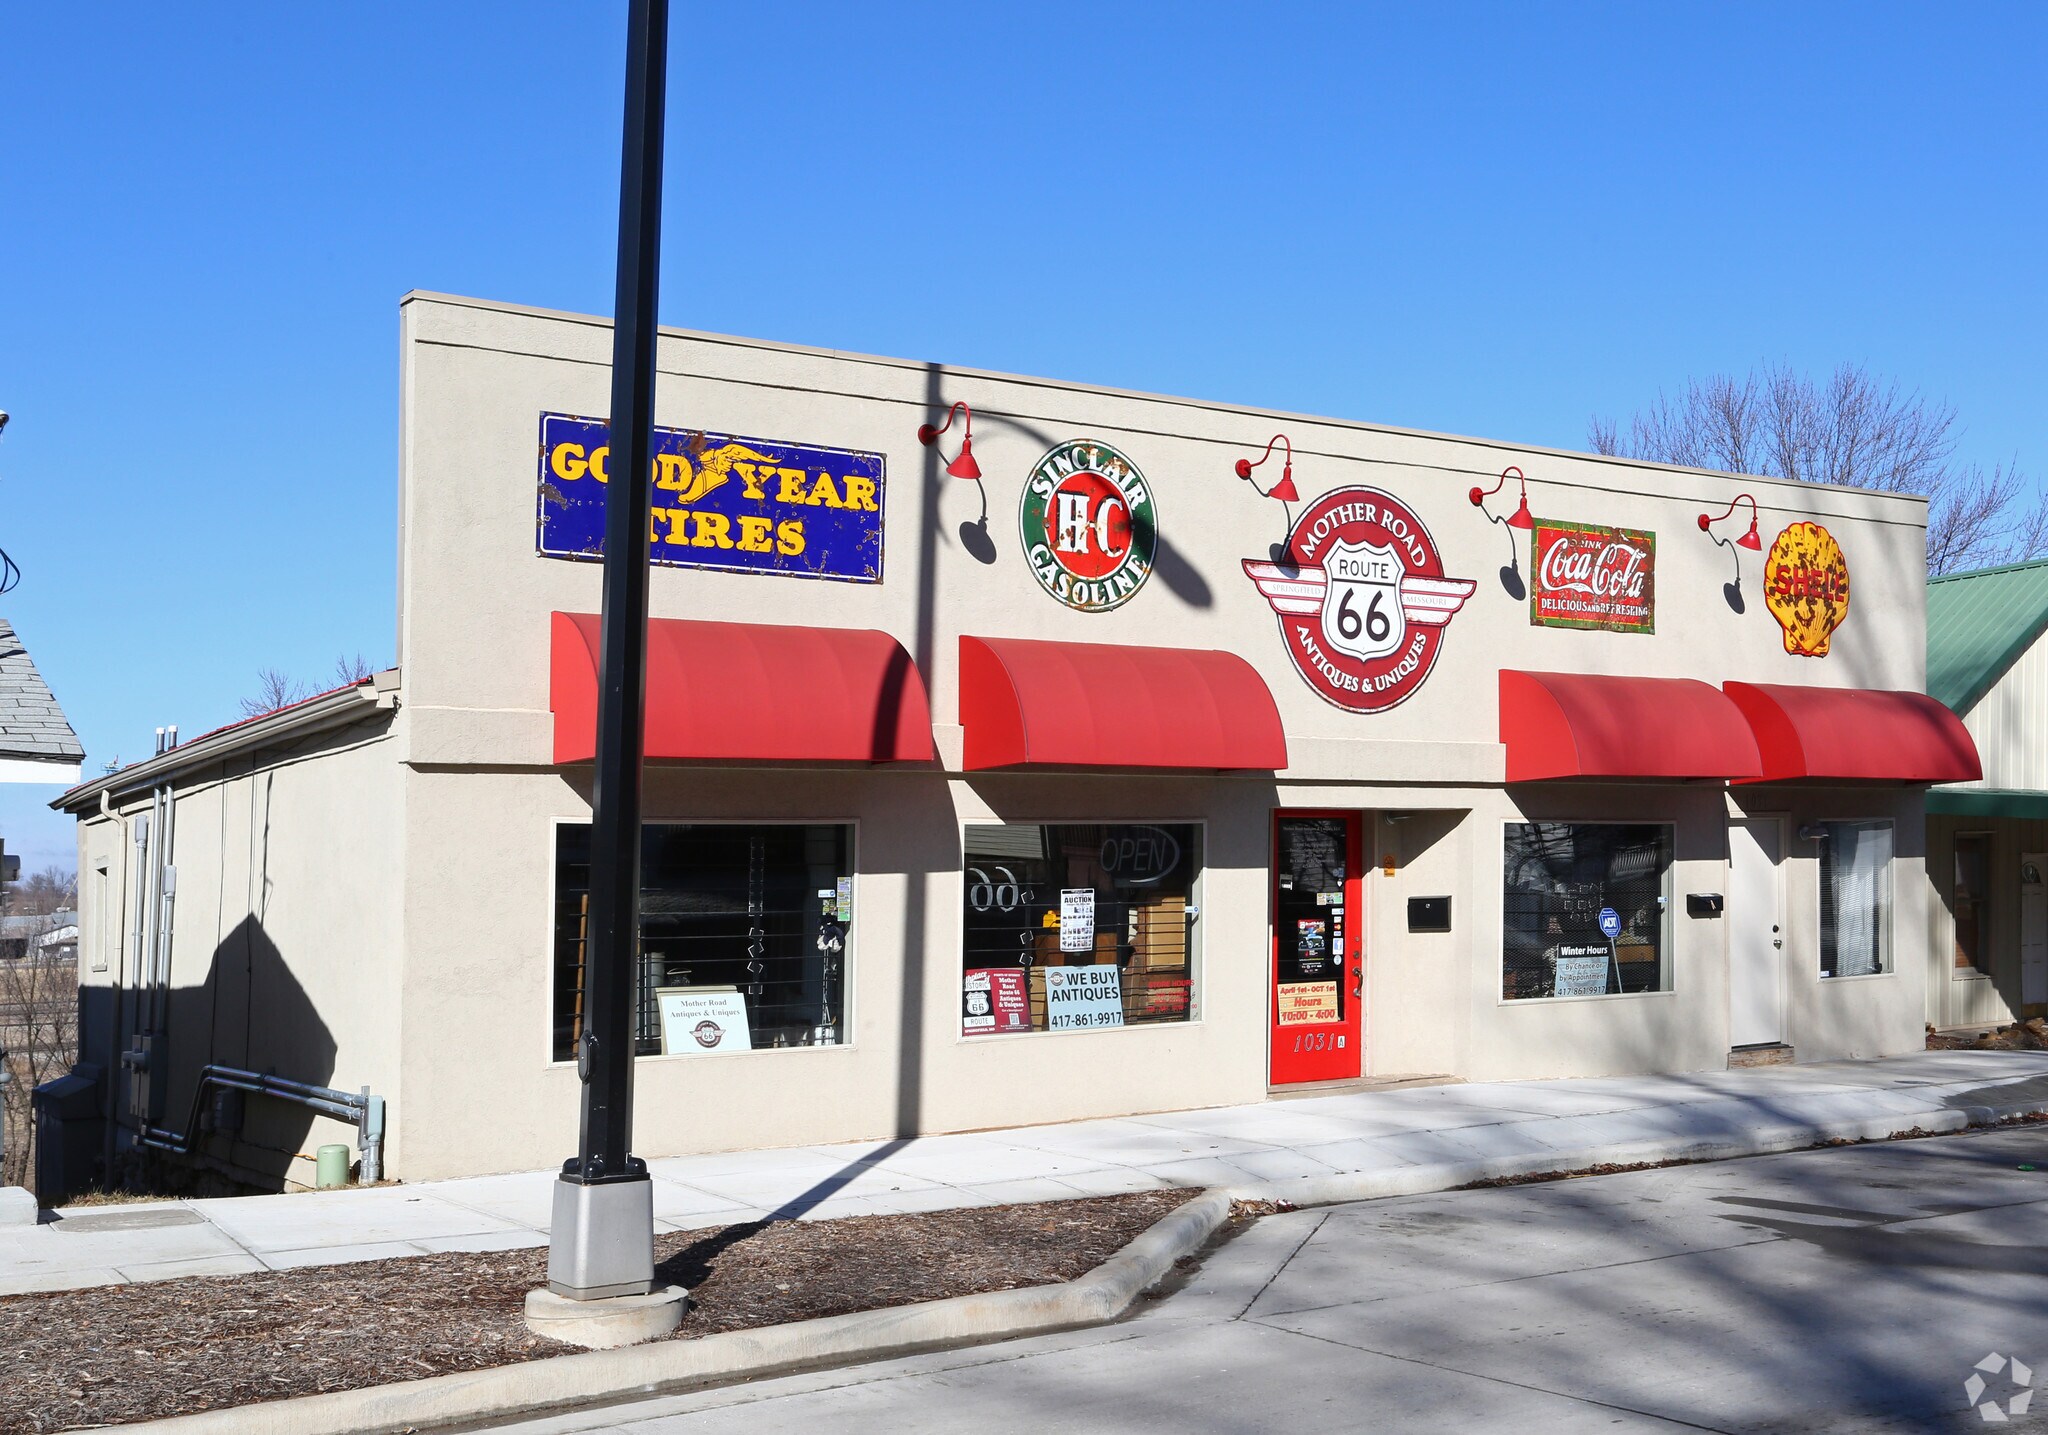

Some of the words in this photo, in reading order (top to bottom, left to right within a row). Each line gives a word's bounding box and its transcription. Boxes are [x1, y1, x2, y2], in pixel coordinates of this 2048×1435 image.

[1030, 446, 1147, 511] SINCLAIR
[1300, 502, 1377, 560] MOTHER
[1381, 508, 1426, 567] ROAD
[1030, 543, 1147, 604] GASOLINE
[1338, 558, 1389, 579] ROUTE
[1272, 583, 1321, 595] SPRINGFIELD
[1774, 565, 1845, 603] SHELL
[1406, 596, 1447, 606] MISSOURI
[1541, 598, 1587, 612] DELICIOUS
[1337, 587, 1390, 642] 66
[1296, 624, 1359, 693] ANTIQUES
[1361, 677, 1375, 694] &
[1375, 631, 1427, 691] UNIQUES
[1100, 838, 1166, 871] OPEN
[1064, 896, 1092, 904] AUCTION
[1604, 917, 1617, 928] ADT
[1561, 946, 1586, 956] Winter
[1586, 945, 1608, 955] Hours
[1574, 962, 1596, 970] Chance
[1066, 973, 1087, 986] WE
[1090, 971, 1116, 985] BUY
[1568, 973, 1606, 981] Appointment
[1051, 987, 1119, 1003] ANTIQUES
[1280, 986, 1296, 995] April
[680, 1000, 706, 1008] Mother
[972, 1003, 985, 1011] 66
[1293, 997, 1322, 1007] Hours
[670, 1010, 701, 1019] Antiques
[712, 1009, 741, 1017] Uniques
[1051, 1012, 1122, 1028] 417-861-9917
[1281, 1010, 1307, 1021] 10:00
[1315, 1009, 1336, 1019] 4:00
[970, 1018, 989, 1026] ROUTE
[703, 1032, 714, 1040] 66
[1294, 1033, 1335, 1053] 1031
